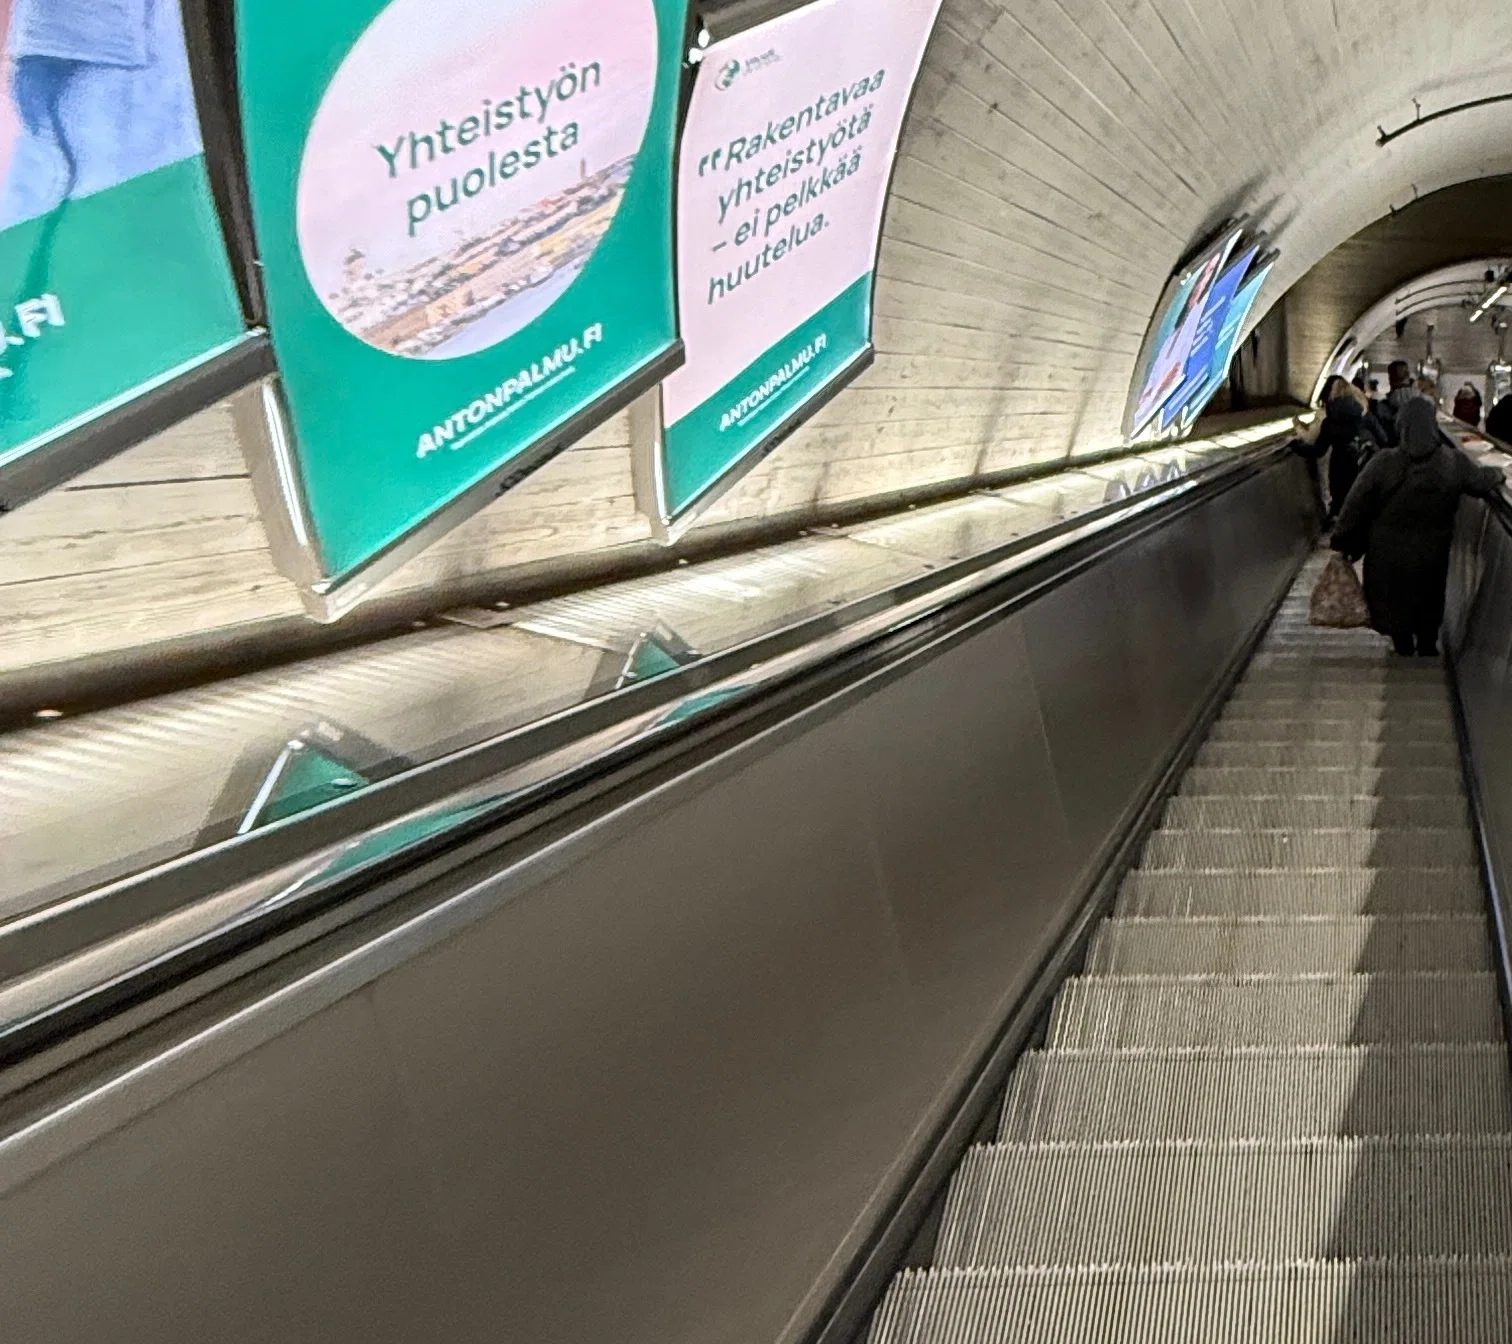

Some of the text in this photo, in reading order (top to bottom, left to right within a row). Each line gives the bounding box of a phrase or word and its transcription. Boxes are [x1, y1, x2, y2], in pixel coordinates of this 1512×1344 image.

[374, 61, 601, 179] Yhteistyön
[718, 103, 874, 225] yhteistyötä
[407, 121, 579, 237] puolesta
[734, 207, 760, 246] ei
[764, 145, 863, 237] pelkkää
[707, 212, 830, 305] huutelua.
[416, 323, 603, 458] ANTONPALMU.FI
[719, 334, 828, 432] ANTONPALMU.FI
